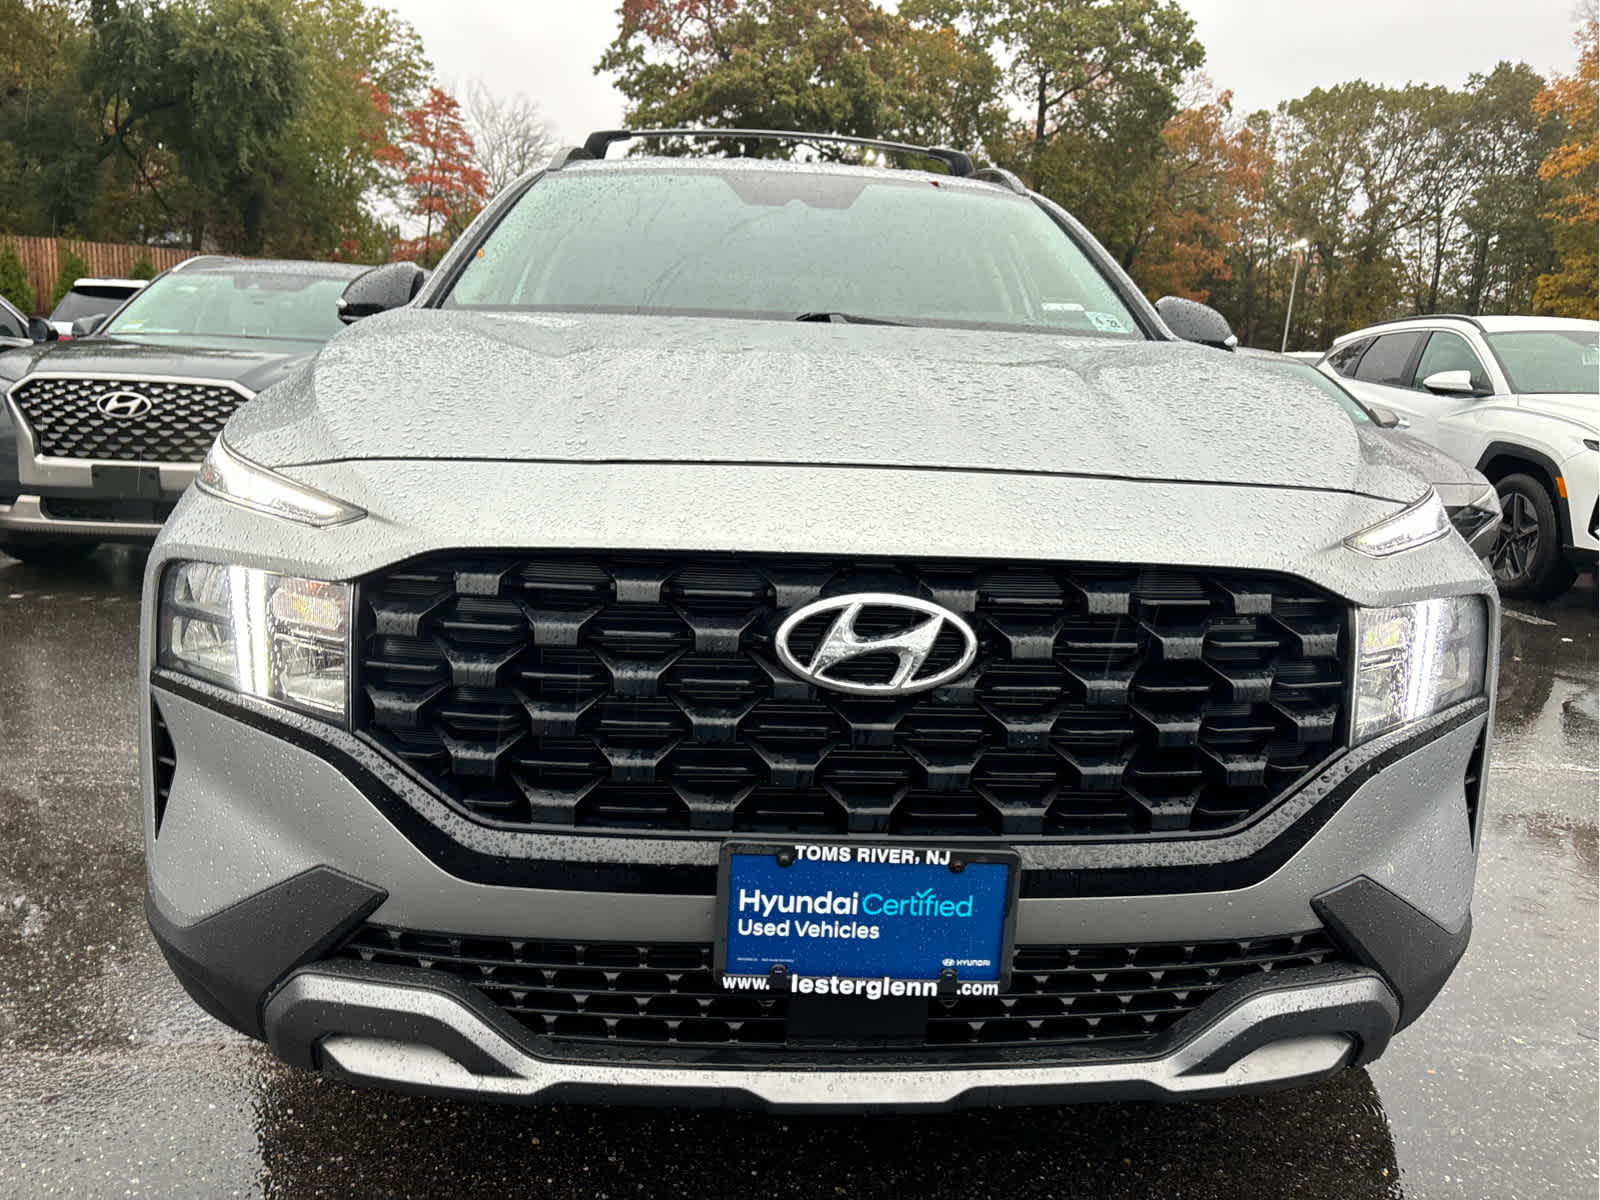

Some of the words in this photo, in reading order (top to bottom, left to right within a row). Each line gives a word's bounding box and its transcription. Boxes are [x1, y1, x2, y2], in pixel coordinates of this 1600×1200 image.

[794, 845, 851, 862] TOMS
[857, 847, 920, 865] RIVER,
[926, 850, 951, 866] NJ
[738, 888, 859, 917] Hyundai
[862, 887, 974, 917] Certified
[737, 918, 790, 937] Used
[794, 920, 880, 939] Vehicles
[722, 976, 770, 991] www.
[791, 974, 938, 1000] lesterglenn
[956, 983, 999, 996] .com
